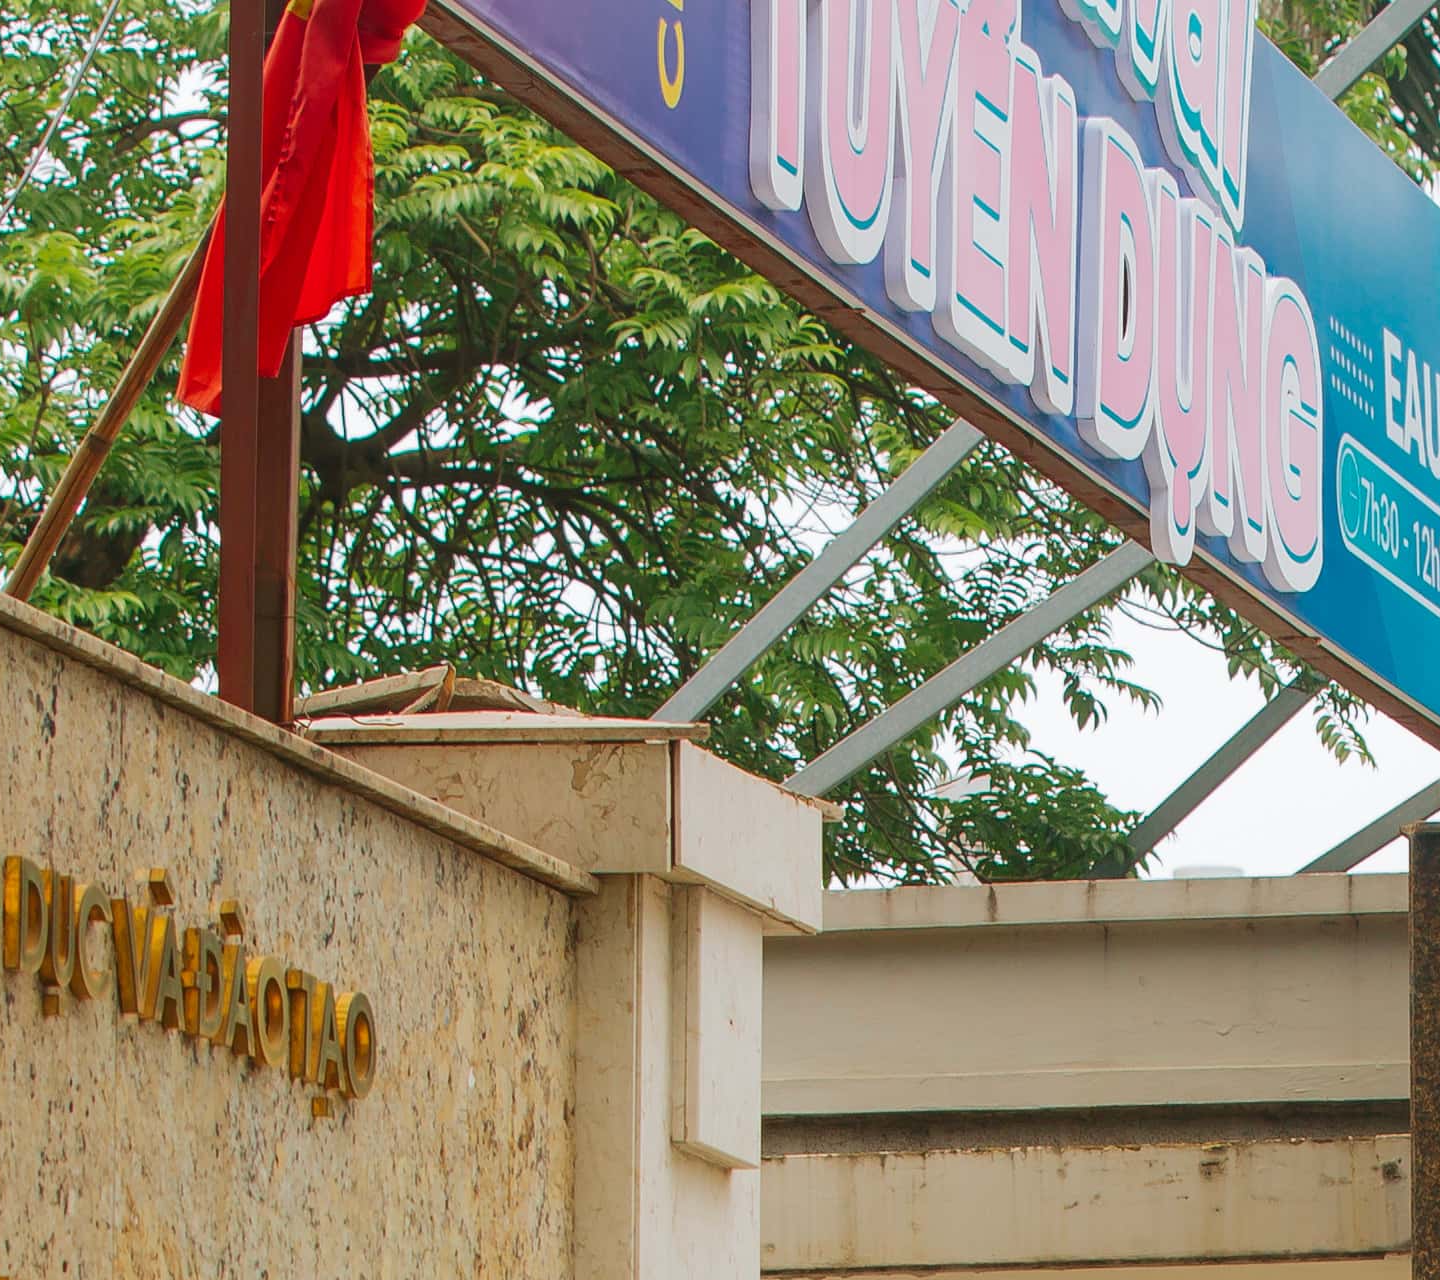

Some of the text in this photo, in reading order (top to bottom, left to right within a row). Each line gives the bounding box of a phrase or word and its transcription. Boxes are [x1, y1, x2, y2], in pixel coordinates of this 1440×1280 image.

[1080, 117, 1324, 592] DỤNG
[1360, 476, 1401, 560] 7h30
[2, 855, 113, 1015] DỤC
[112, 868, 183, 1031] VÀ
[182, 899, 290, 1070] ĐÀO
[285, 966, 378, 1118] TẠO
